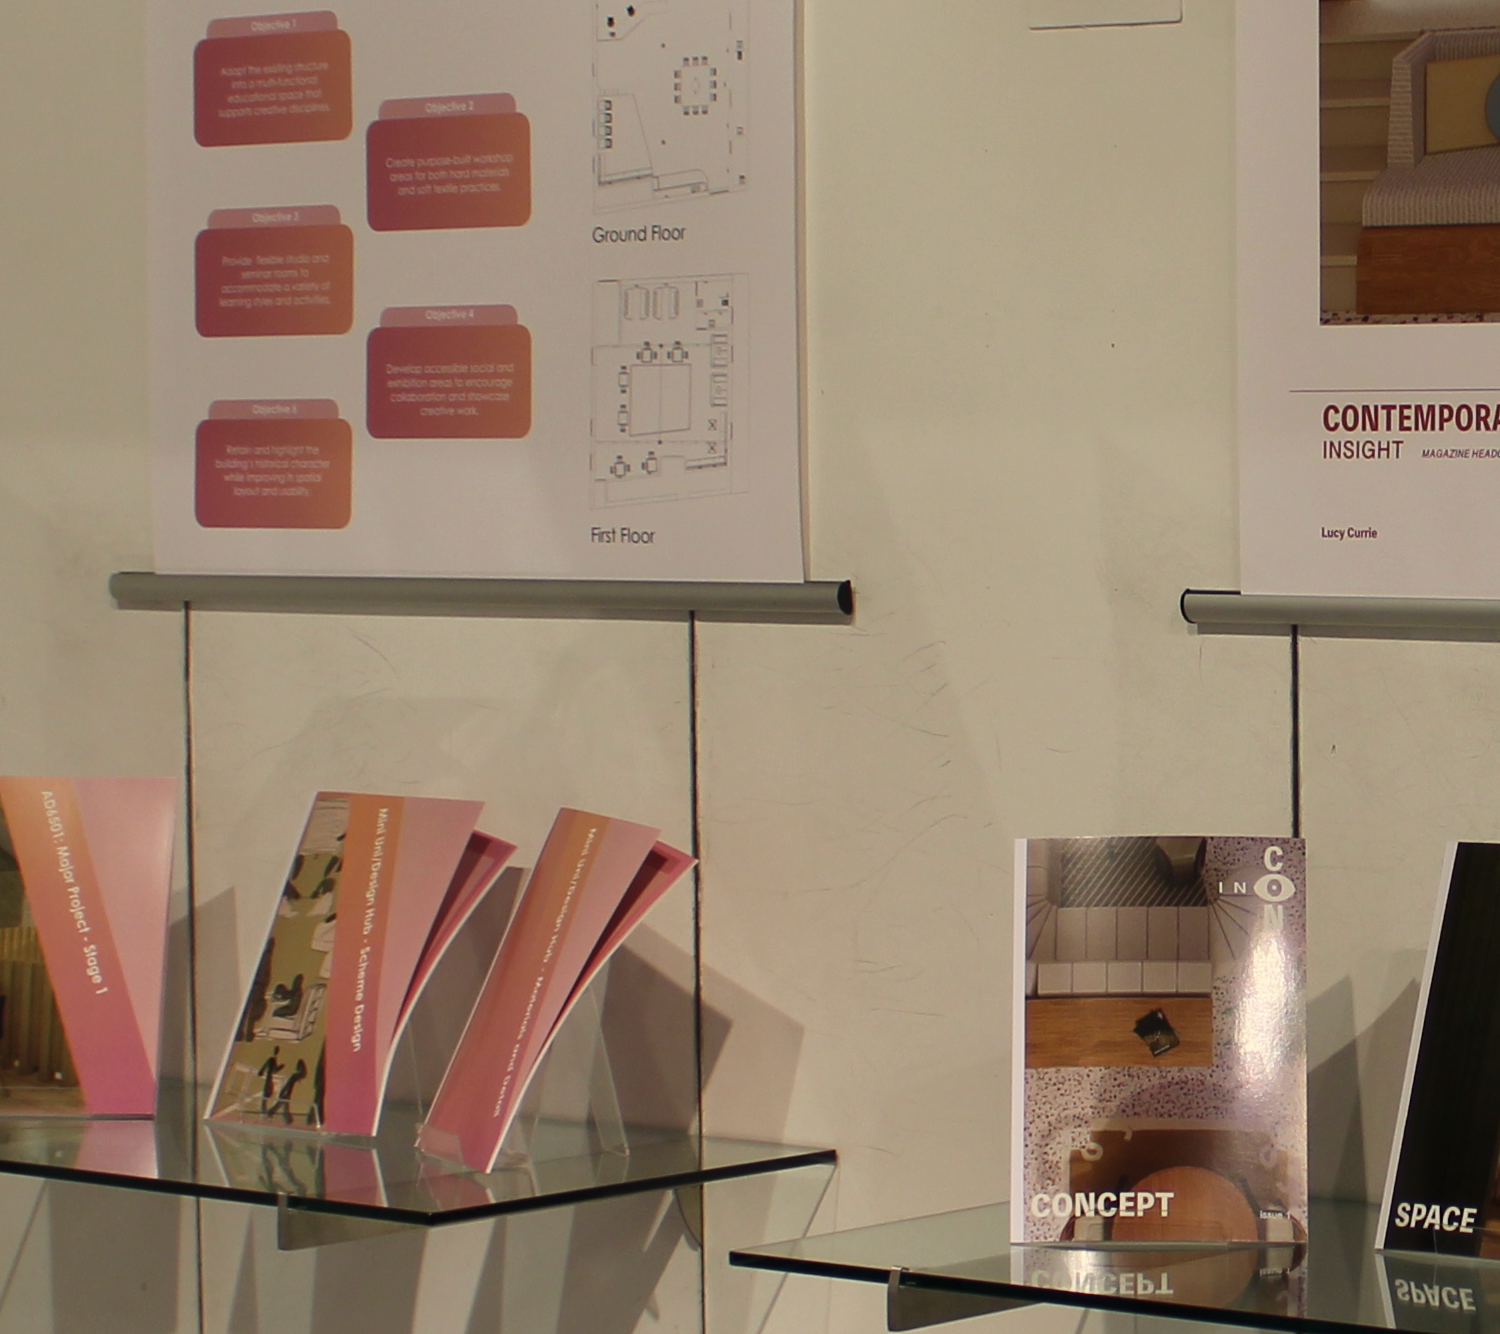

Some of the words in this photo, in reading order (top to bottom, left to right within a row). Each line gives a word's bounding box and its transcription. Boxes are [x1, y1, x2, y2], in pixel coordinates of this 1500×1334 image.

[425, 103, 467, 114] Objective
[592, 225, 646, 243] Ground
[652, 225, 686, 241] Floor
[425, 310, 466, 322] Objective
[1323, 440, 1404, 459] INSIGHT
[1422, 449, 1470, 458] MAGAZINE
[591, 527, 616, 543] First
[621, 527, 655, 544] Floor
[1321, 527, 1345, 541] Lucy
[1347, 527, 1378, 538] Currie
[374, 807, 389, 835] Mini
[365, 836, 385, 905] Uni/Design
[56, 846, 75, 883] Major
[67, 887, 91, 934] Project
[83, 944, 103, 984] Stage
[96, 986, 108, 995] 1
[363, 907, 377, 935] Hub
[355, 946, 371, 1002] Scheme
[351, 1003, 365, 1053] Design
[1030, 1191, 1174, 1218] CONCEPT
[1394, 1202, 1478, 1234] SPACE
